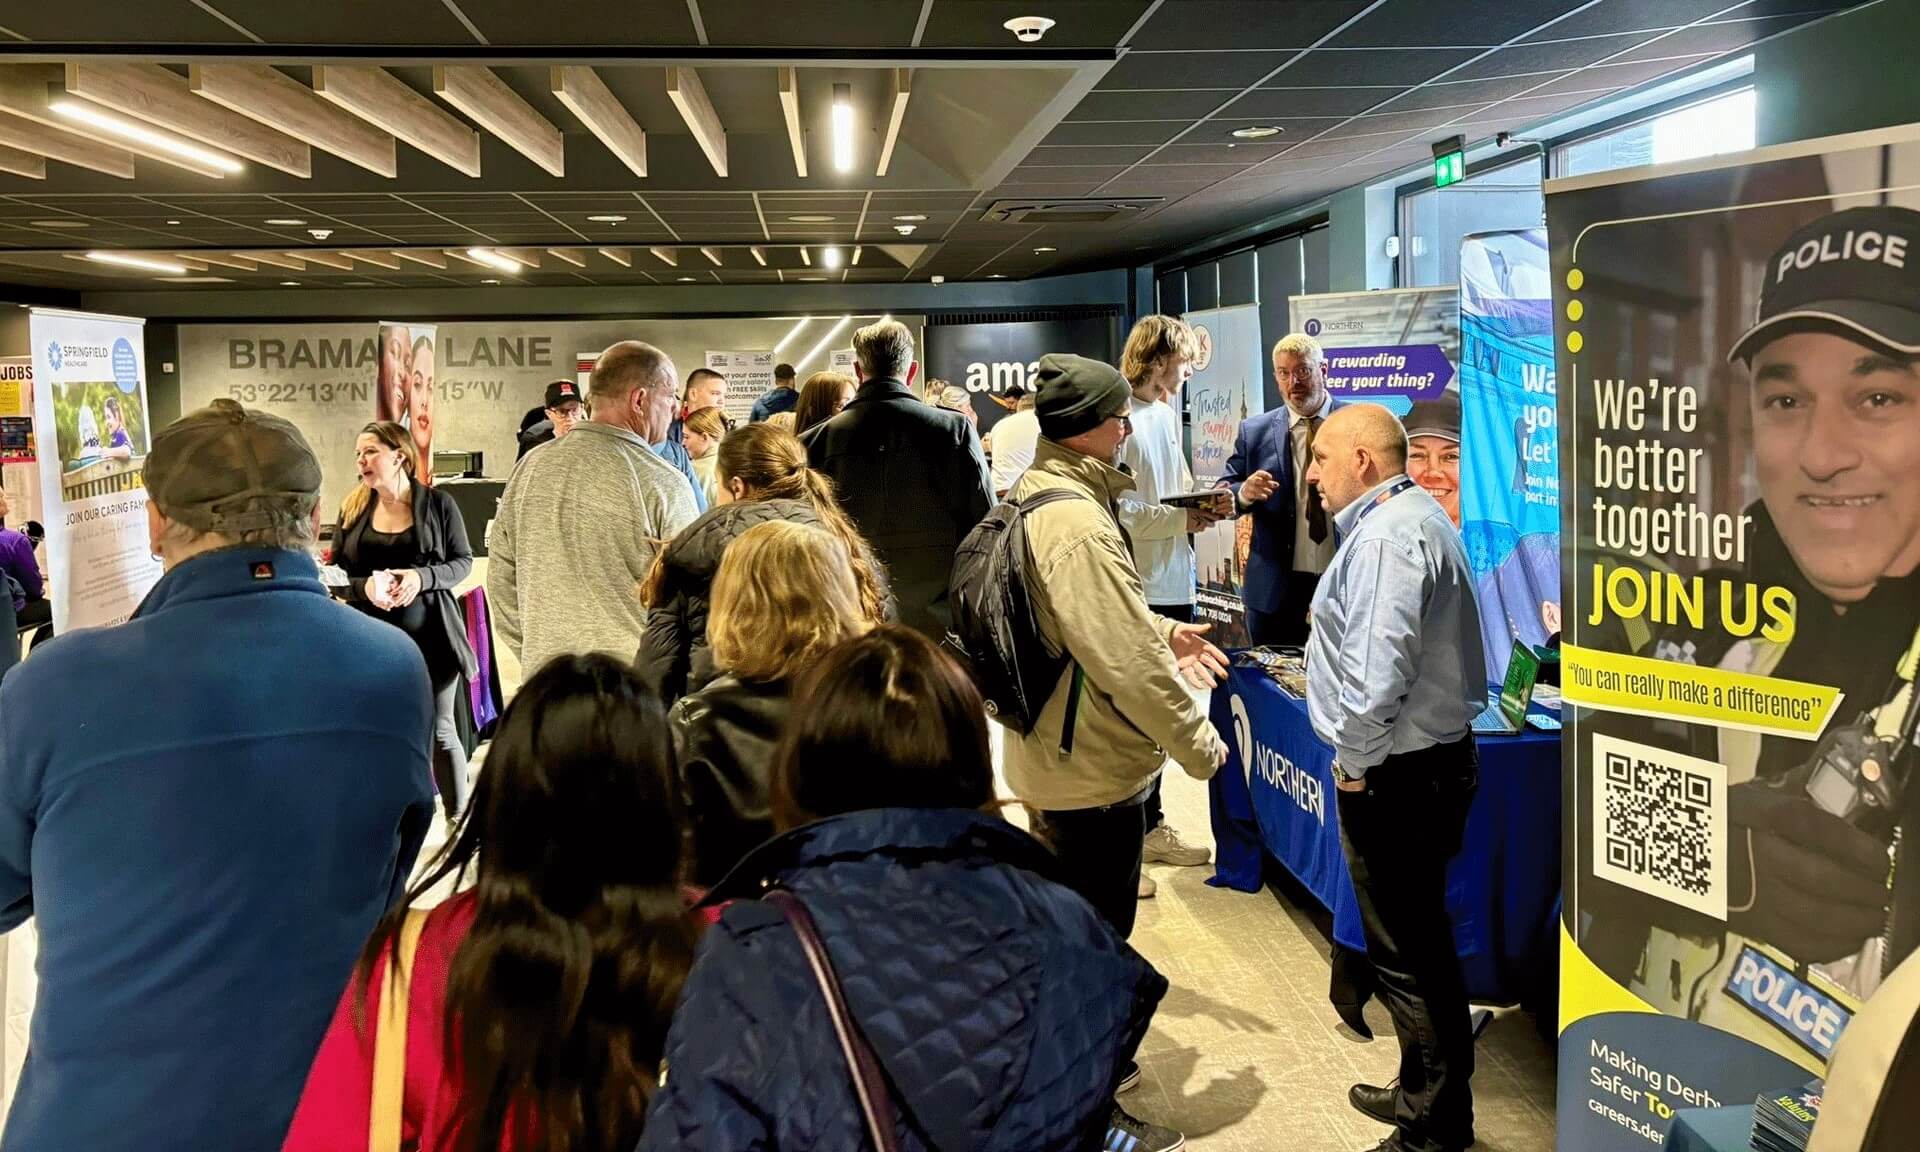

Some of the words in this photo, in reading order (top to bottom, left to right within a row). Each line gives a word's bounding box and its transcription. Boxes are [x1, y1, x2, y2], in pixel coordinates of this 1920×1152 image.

[1776, 230, 1909, 284] POLICE
[1323, 319, 1364, 331] NORTHERN
[63, 346, 109, 358] SPRINGFIELD
[229, 338, 378, 369] BRAMA
[445, 336, 553, 368] LANE
[1331, 353, 1406, 370] rewarding
[0, 365, 33, 381] JOBS
[966, 361, 1040, 393] ama
[1326, 377, 1349, 388] eer
[1352, 376, 1384, 391] your
[1386, 372, 1435, 391] thing?
[1521, 363, 1555, 395] Wa
[1193, 389, 1232, 421] Trusted
[1523, 404, 1557, 434] yo
[1593, 378, 1698, 433] We’re
[1594, 437, 1703, 495] better
[66, 511, 84, 526] JOIN
[84, 507, 100, 521] OUR
[100, 502, 129, 518] CARING
[130, 499, 145, 512] FAM
[1592, 496, 1753, 563] together
[1588, 564, 1704, 630] JOIN
[1720, 579, 1796, 644] US
[1596, 669, 1621, 692] can
[1625, 673, 1665, 701] really
[1669, 679, 1709, 706] make
[1713, 686, 1723, 707] a
[1256, 739, 1325, 828] NORTHERN
[1733, 955, 1841, 1049] POLICE
[1590, 1039, 1662, 1091] Making
[1666, 1073, 1721, 1109] Derb
[1590, 1066, 1642, 1105] Safer
[1643, 1091, 1676, 1120] To
[1588, 1098, 1664, 1145] careers.der
